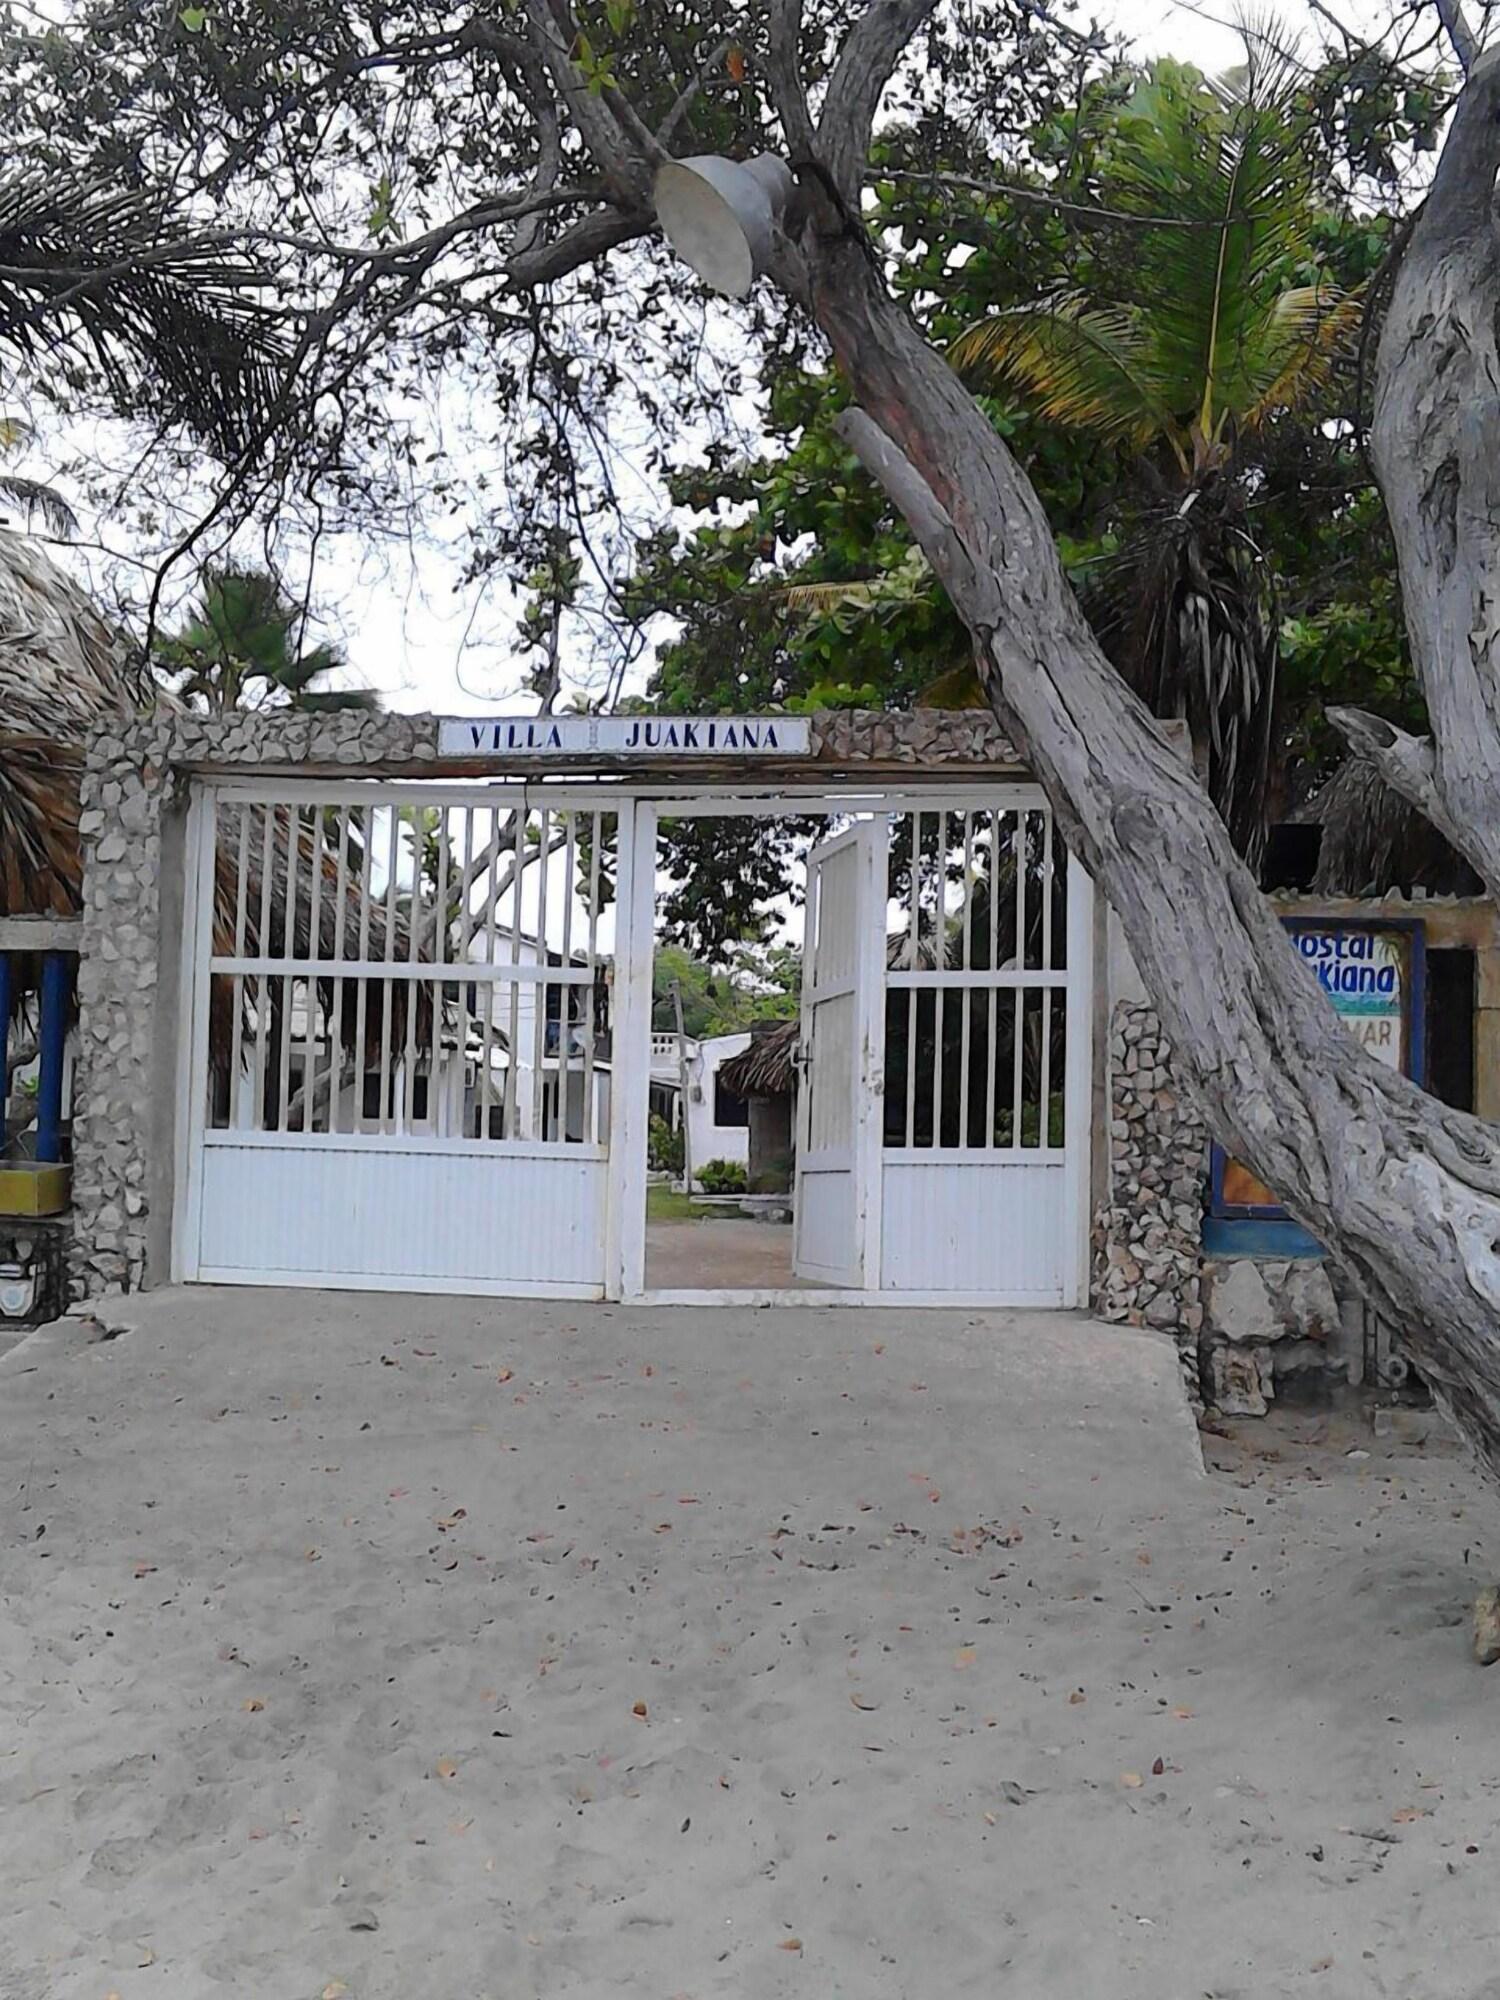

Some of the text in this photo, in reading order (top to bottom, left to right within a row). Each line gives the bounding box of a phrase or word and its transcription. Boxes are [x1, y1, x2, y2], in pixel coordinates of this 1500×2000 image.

[471, 722, 778, 749] VILLA JUAKIANA
[1312, 960, 1395, 992] kiana
